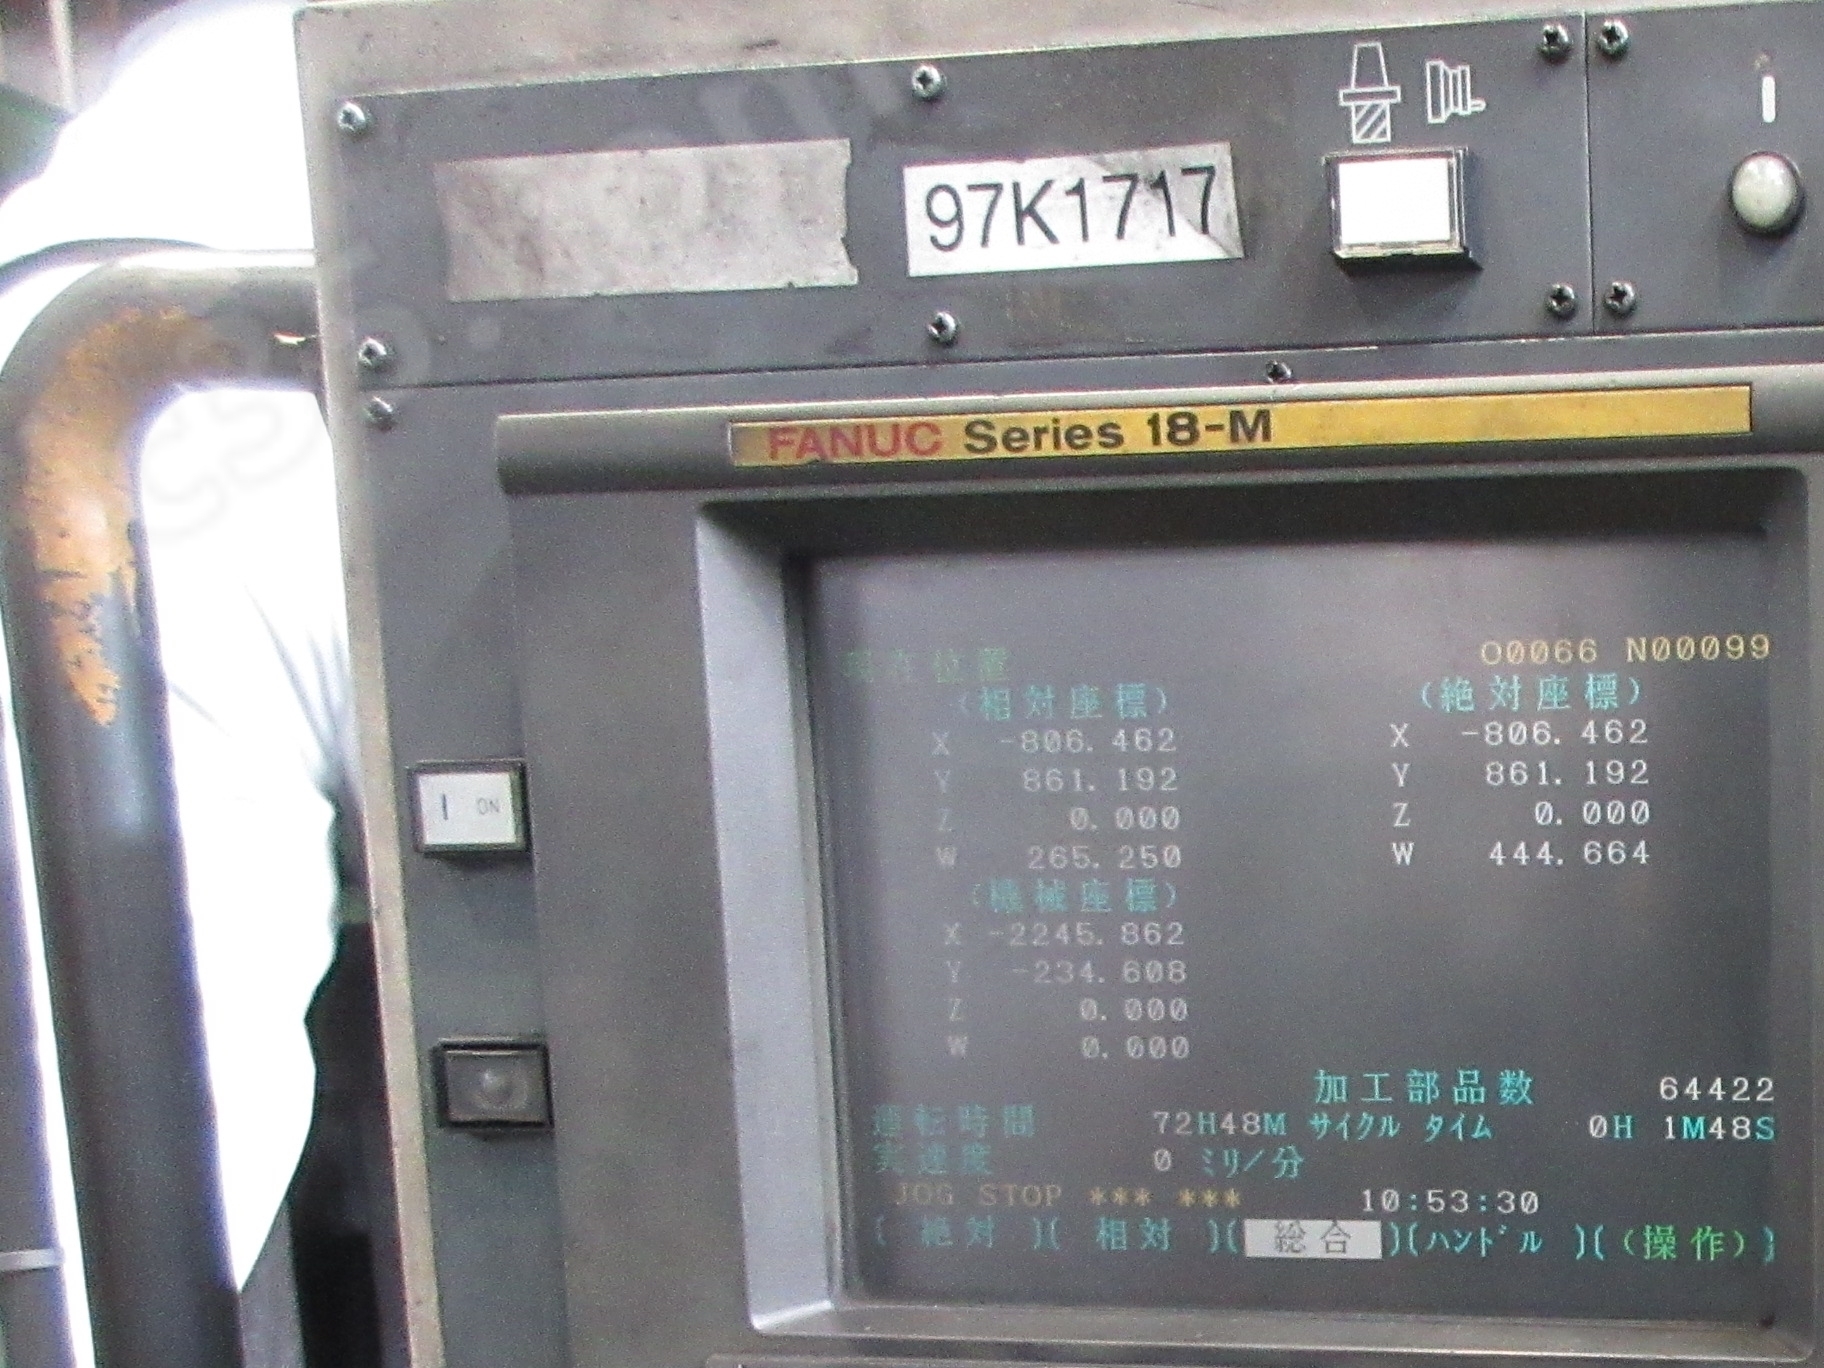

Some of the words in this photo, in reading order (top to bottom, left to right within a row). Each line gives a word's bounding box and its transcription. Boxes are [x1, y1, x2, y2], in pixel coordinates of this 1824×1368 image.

[925, 164, 1219, 253] 97K1717
[766, 420, 943, 463] FANUC
[963, 416, 1125, 457] Series
[1146, 408, 1273, 449] 18-M
[1625, 632, 1772, 663] N00099
[1389, 722, 1411, 749] X
[1391, 761, 1411, 789] Y
[1393, 802, 1412, 828] Z
[1390, 841, 1415, 867] W
[1314, 1068, 1535, 1106] 加工部品数
[1658, 1075, 1776, 1103] 64422
[1151, 1110, 1288, 1137] 72H48M
[978, 1182, 1062, 1208] STOP
[1361, 1188, 1541, 1216] 10:53:30
